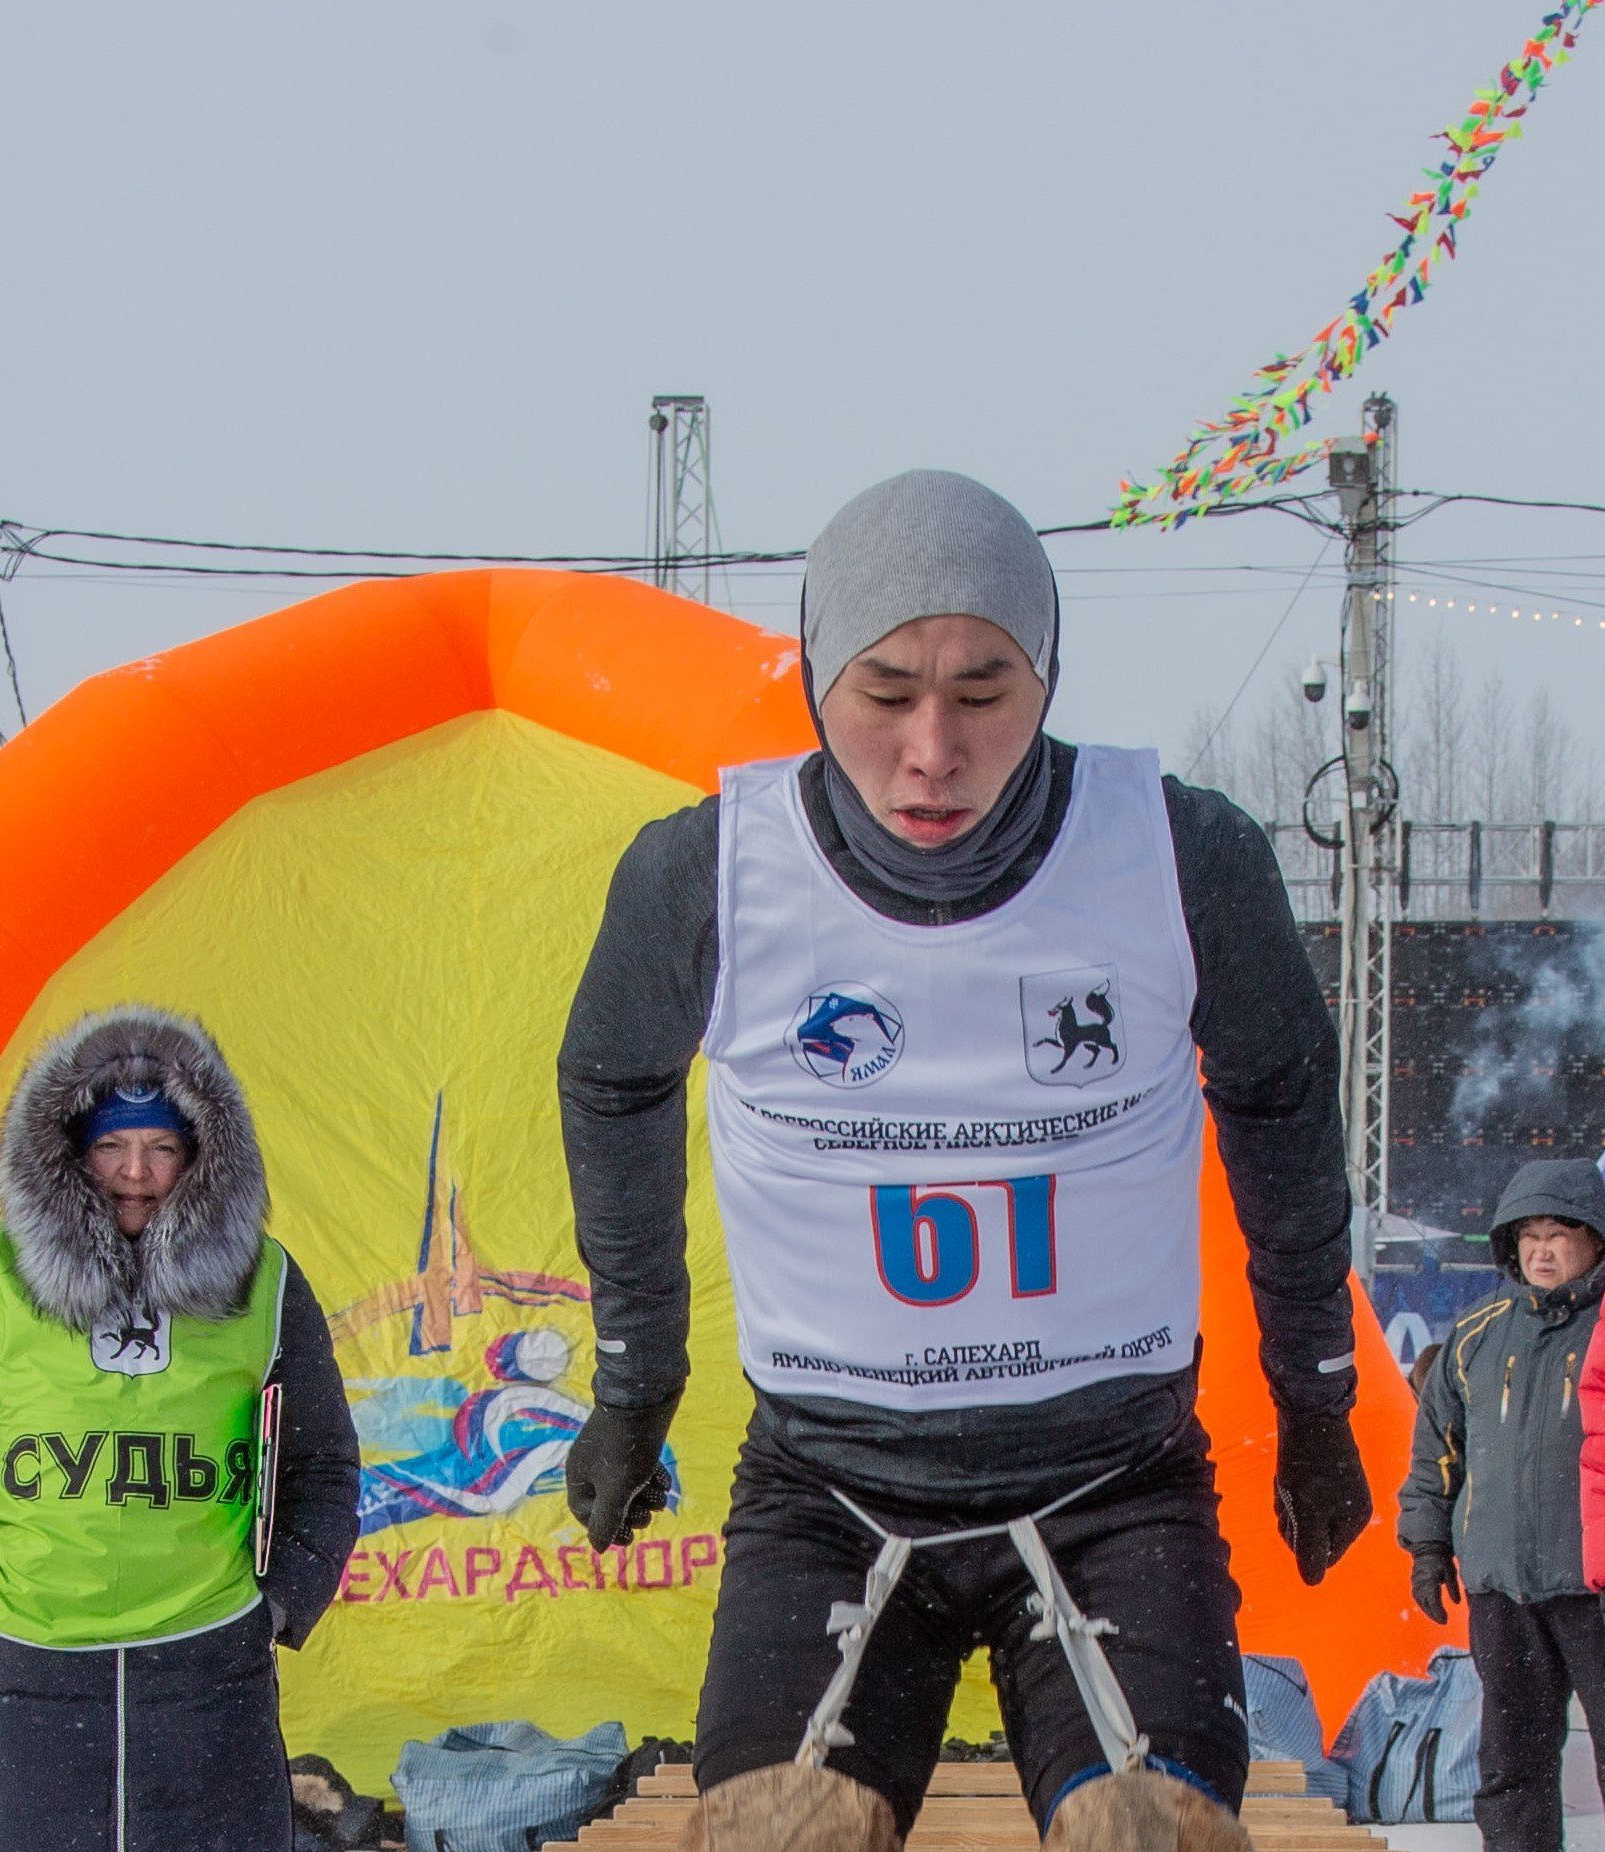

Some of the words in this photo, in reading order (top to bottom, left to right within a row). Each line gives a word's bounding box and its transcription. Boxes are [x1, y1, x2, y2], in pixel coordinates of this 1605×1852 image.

[953, 1101, 1118, 1140] АРКТИЧЕСКИЕ
[772, 1351, 960, 1386] ЯМАЛО-НЕНЕЦКИЙ
[1121, 1326, 1173, 1359] ОКРУГ
[905, 1353, 918, 1367] г.
[924, 1339, 1043, 1366] САЛЕХАРД
[2, 1430, 254, 1510] СУДЬЯ
[338, 1534, 727, 1605] ЕХАРДСПОР
